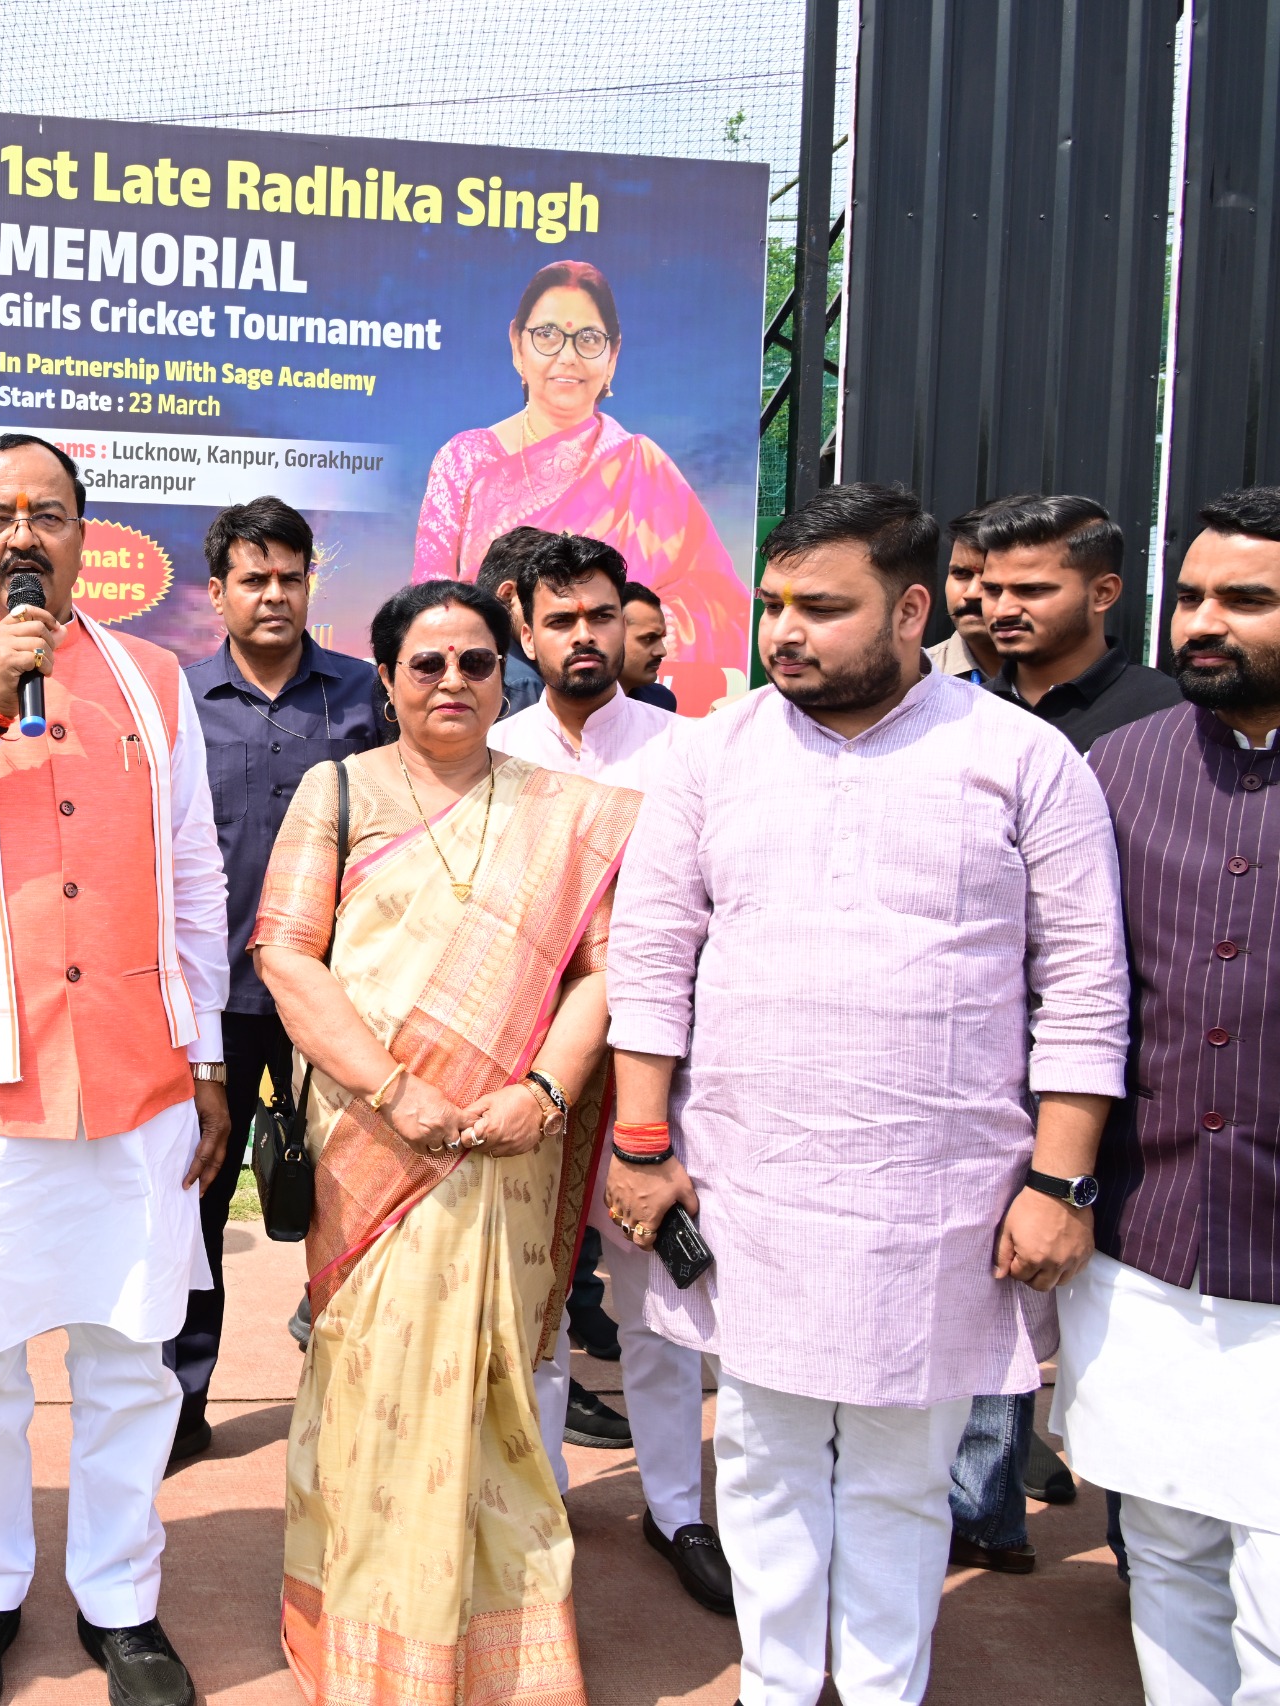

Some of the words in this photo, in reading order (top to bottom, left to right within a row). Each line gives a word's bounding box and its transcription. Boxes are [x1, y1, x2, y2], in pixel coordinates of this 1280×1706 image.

[1, 145, 78, 200] 1st
[94, 152, 211, 208] Late
[227, 160, 443, 223] Radhika
[457, 176, 599, 244] Singh
[90, 298, 216, 338] Cricket
[224, 305, 442, 351] Tournament
[0, 352, 21, 373] In
[27, 353, 159, 384] Partnership
[165, 361, 216, 382] With
[223, 363, 273, 390] Sage
[279, 367, 376, 395] Academy
[60, 388, 112, 412] Date
[117, 396, 124, 413] :
[129, 392, 152, 413] 23
[158, 394, 220, 416] March
[112, 441, 201, 467] Lucknow,
[207, 445, 279, 469] Kanpur,
[284, 448, 384, 475] Gorakhpur
[84, 468, 196, 495] Saharanpur
[81, 547, 131, 569] mat
